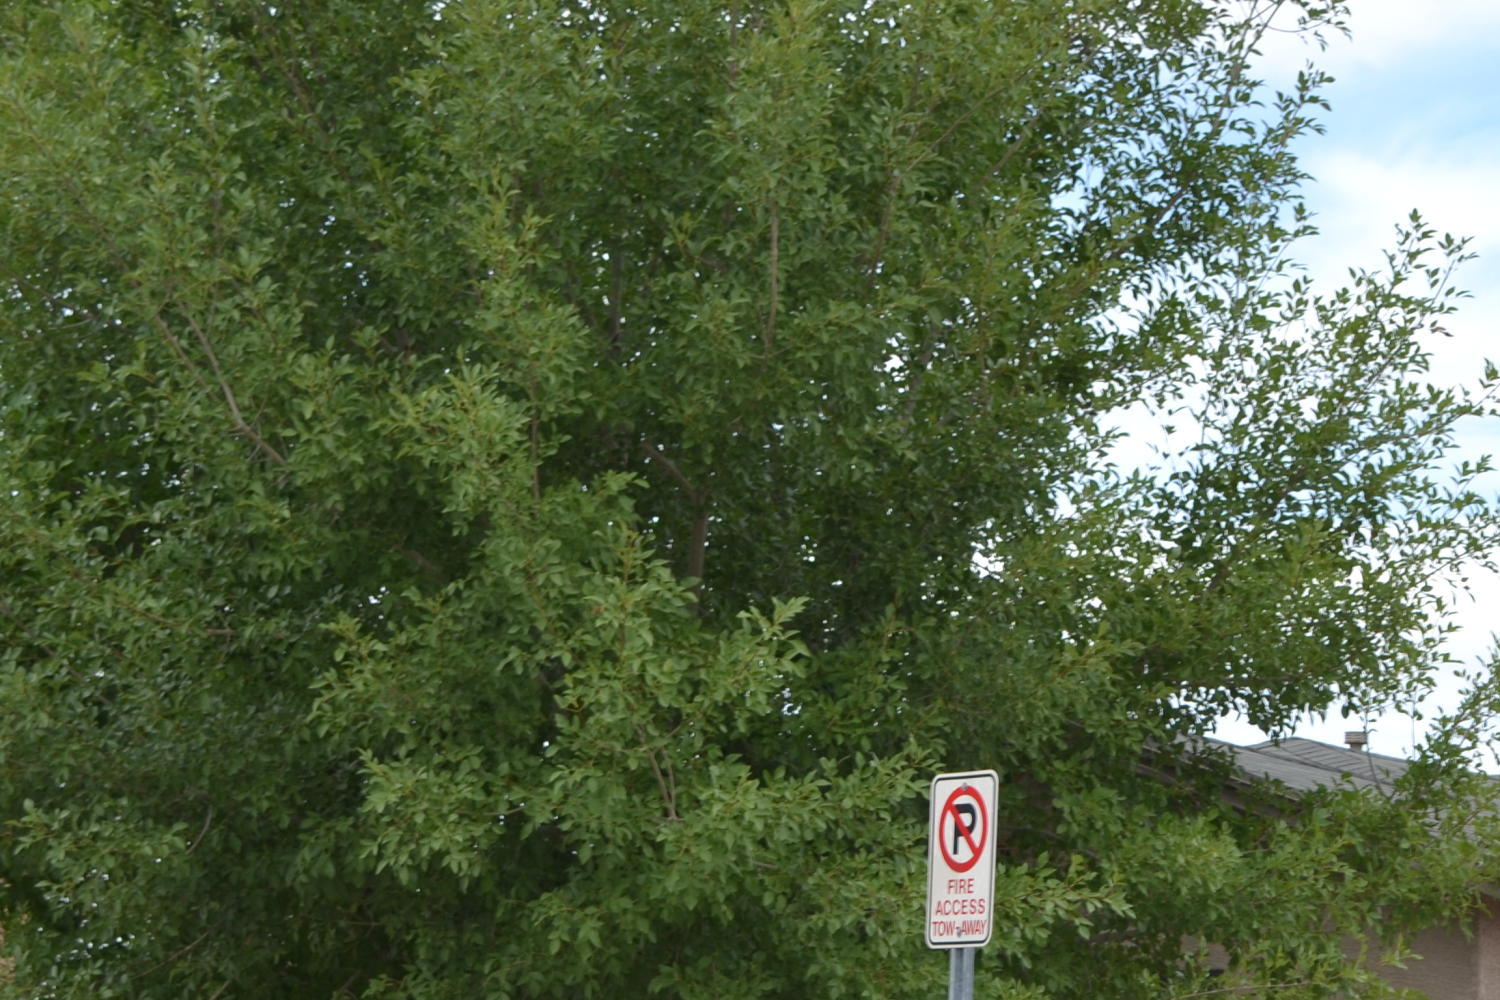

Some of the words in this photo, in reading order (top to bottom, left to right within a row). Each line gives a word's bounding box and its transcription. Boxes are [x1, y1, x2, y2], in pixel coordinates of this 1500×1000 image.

[953, 803, 977, 855] P
[947, 878, 975, 895] FIRE
[935, 898, 986, 916] ACCESS
